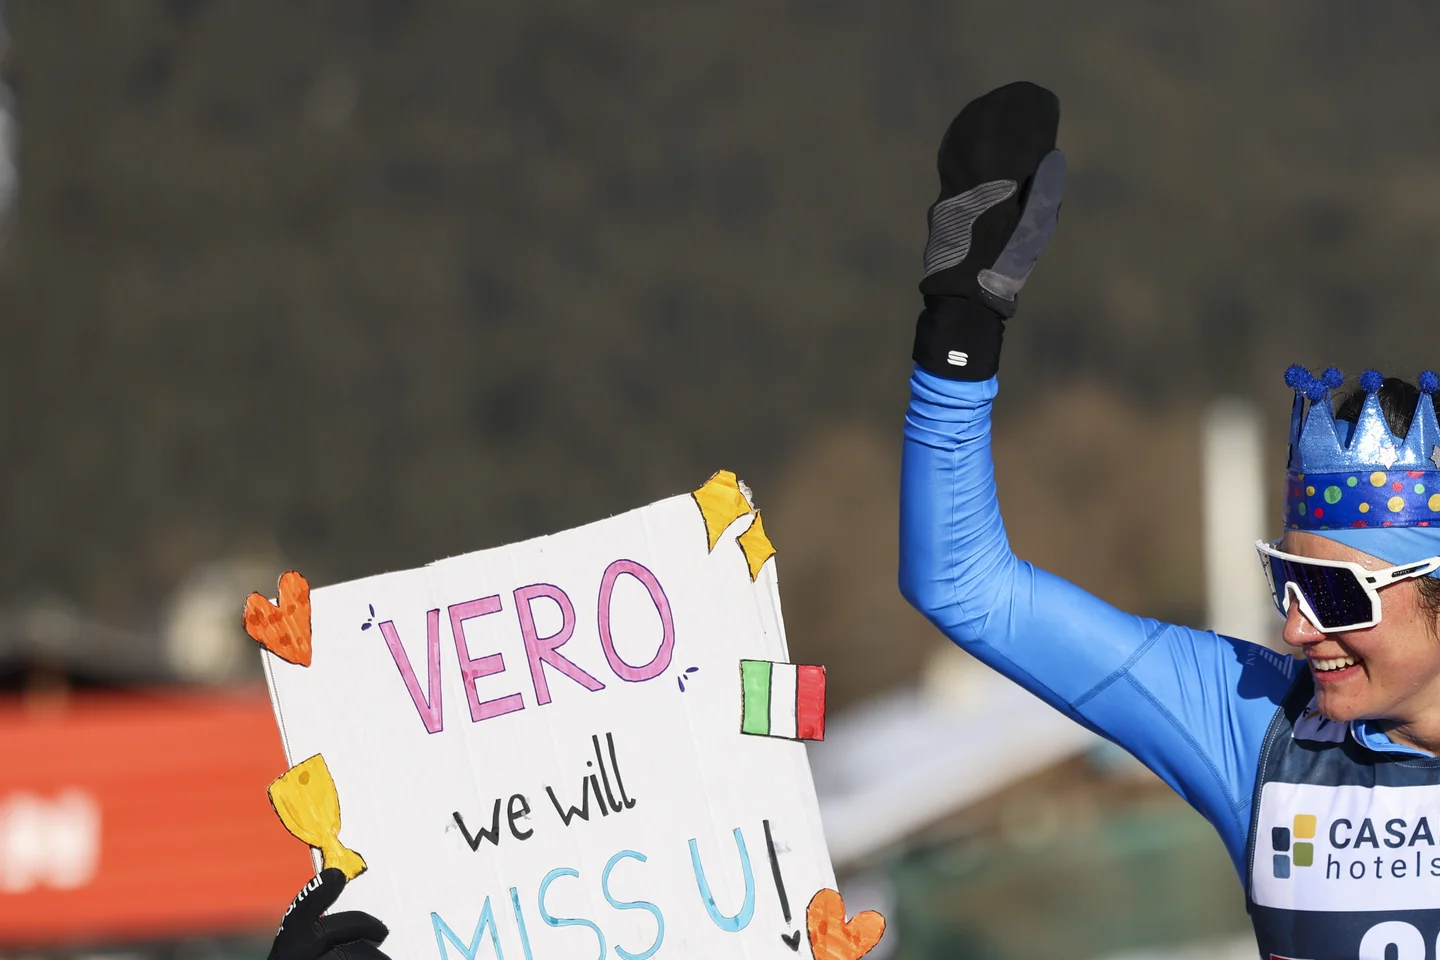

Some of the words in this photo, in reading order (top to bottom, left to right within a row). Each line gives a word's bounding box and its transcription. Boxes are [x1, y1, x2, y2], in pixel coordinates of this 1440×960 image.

[378, 558, 676, 734] VERO
[453, 792, 533, 853] we
[545, 732, 637, 825] will
